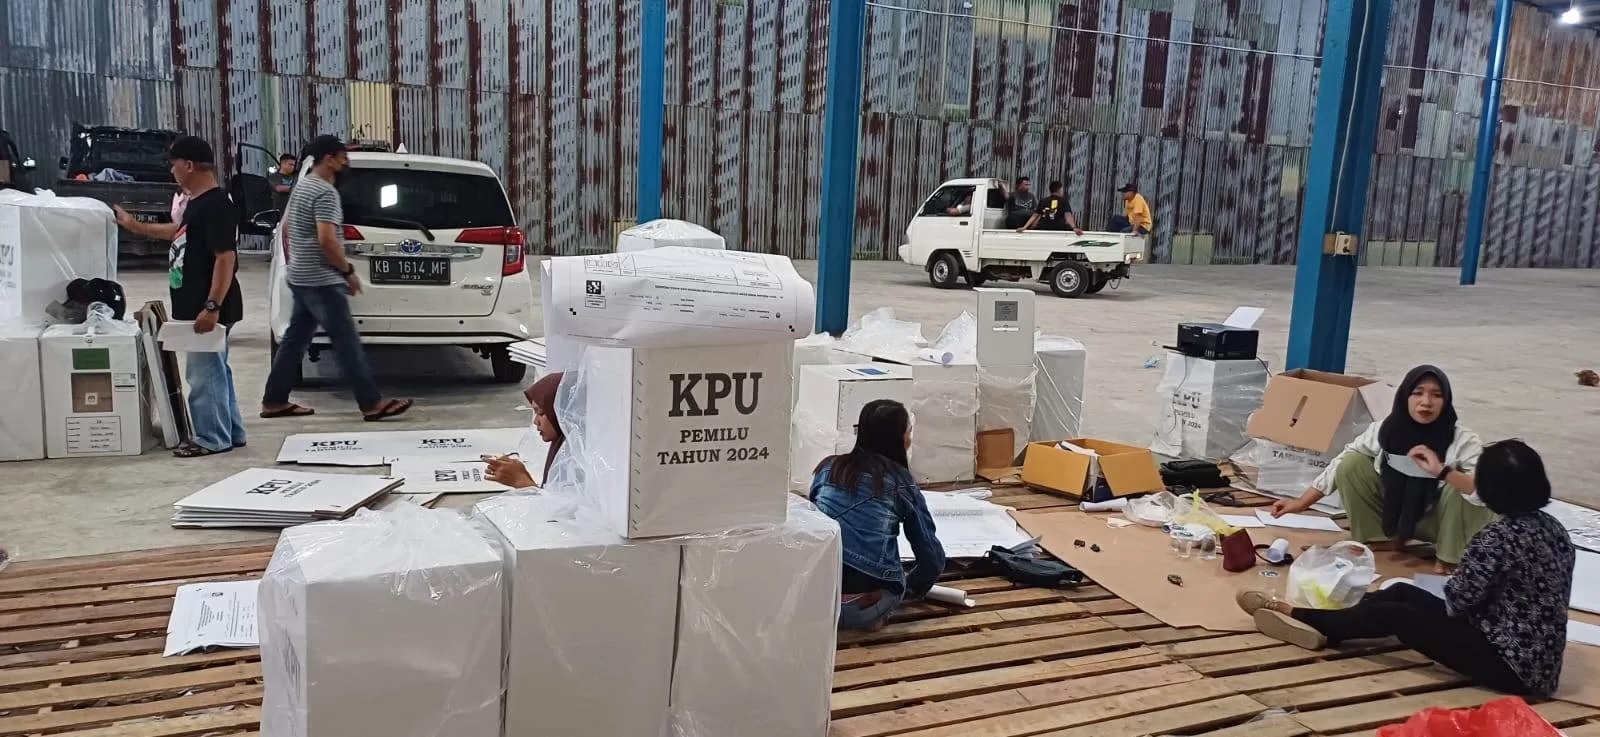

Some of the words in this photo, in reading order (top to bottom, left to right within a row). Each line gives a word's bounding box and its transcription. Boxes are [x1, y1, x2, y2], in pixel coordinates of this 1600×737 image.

[375, 260, 390, 273] KB
[398, 261, 425, 274] 1614
[431, 261, 447, 275] MF
[669, 372, 762, 417] KPU
[680, 427, 749, 443] PEMILU
[657, 449, 721, 465] TAHUN
[727, 447, 769, 461] 2024
[434, 470, 457, 482] KPU
[246, 479, 292, 495] KPU
